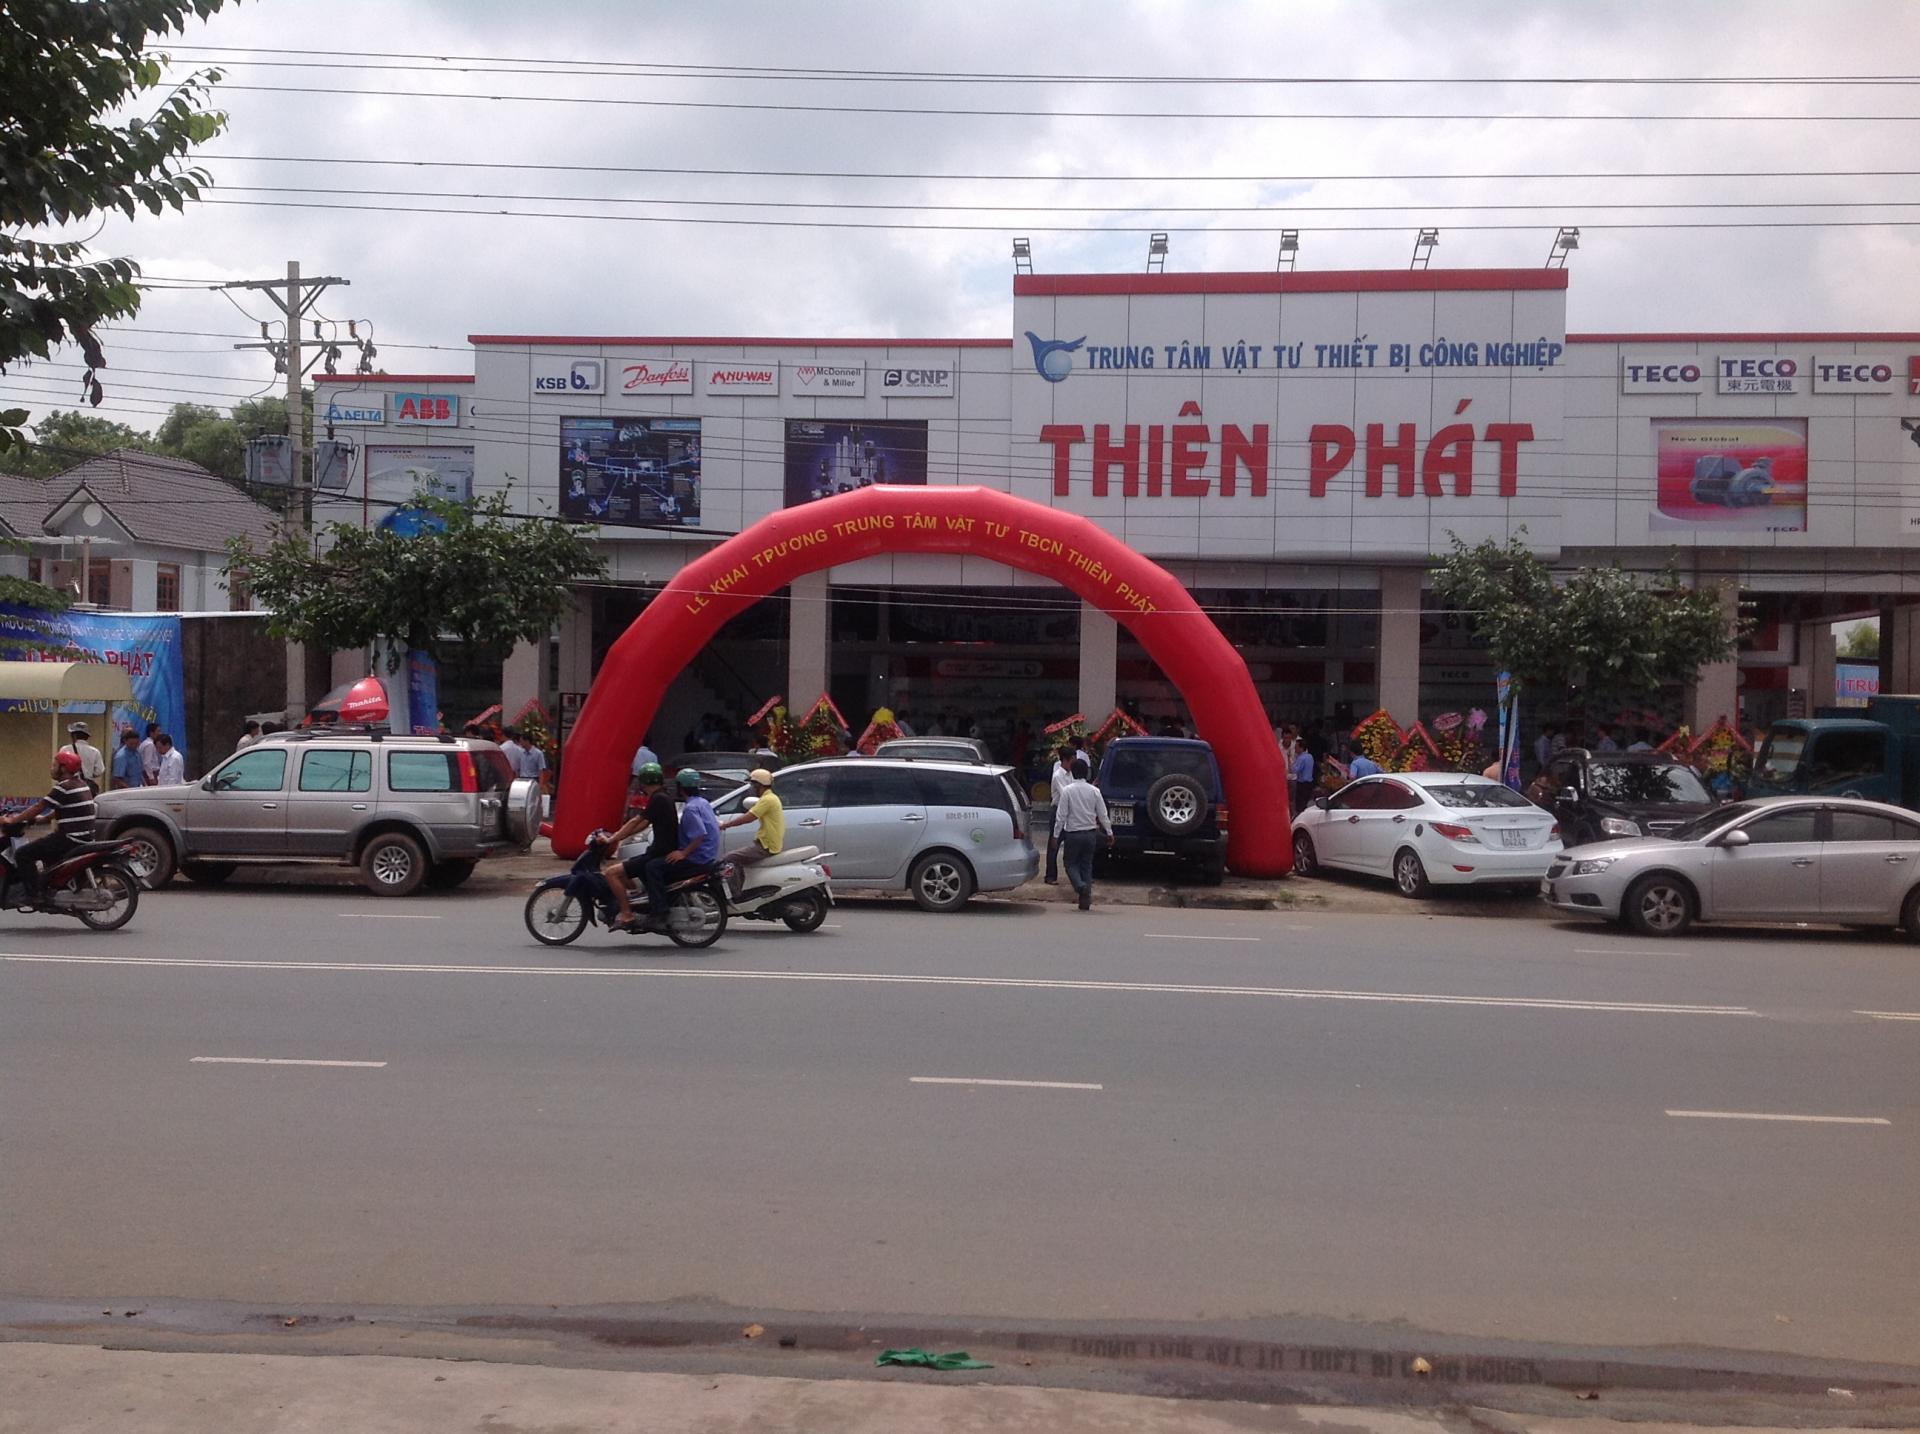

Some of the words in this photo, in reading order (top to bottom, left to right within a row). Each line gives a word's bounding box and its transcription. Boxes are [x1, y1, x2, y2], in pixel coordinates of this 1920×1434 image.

[1087, 346, 1154, 369] TRUNG
[1164, 340, 1211, 369] TÂM
[1222, 339, 1262, 374] VẬT
[1273, 341, 1303, 369] TƯ
[1314, 333, 1378, 368] THIẾT
[1389, 344, 1411, 373] BỊ
[1419, 337, 1478, 367] CÔNG
[1485, 337, 1563, 371] NGHIỆP
[622, 362, 690, 389] Danfoss
[726, 371, 773, 382] NU-WAY
[816, 368, 861, 376] McDonnell
[905, 370, 949, 385] CNP
[1627, 364, 1701, 383] TECO
[1721, 359, 1797, 378] TECO
[1818, 364, 1892, 383] TECO
[536, 377, 566, 390] KSB
[823, 379, 830, 387] &
[832, 378, 855, 387] Miller
[1727, 379, 1793, 392] 東元電機
[400, 398, 450, 420] ABB
[1039, 400, 1269, 497] THIÊN
[1308, 398, 1535, 497] PHÁT
[709, 564, 749, 595] KHAI
[833, 514, 895, 538] TRUNG
[903, 512, 937, 530] TÂM
[945, 514, 976, 533] VẬT
[985, 521, 1010, 539] TƯ
[1018, 529, 1064, 556] TBCN
[1115, 582, 1157, 616] PHÁT
